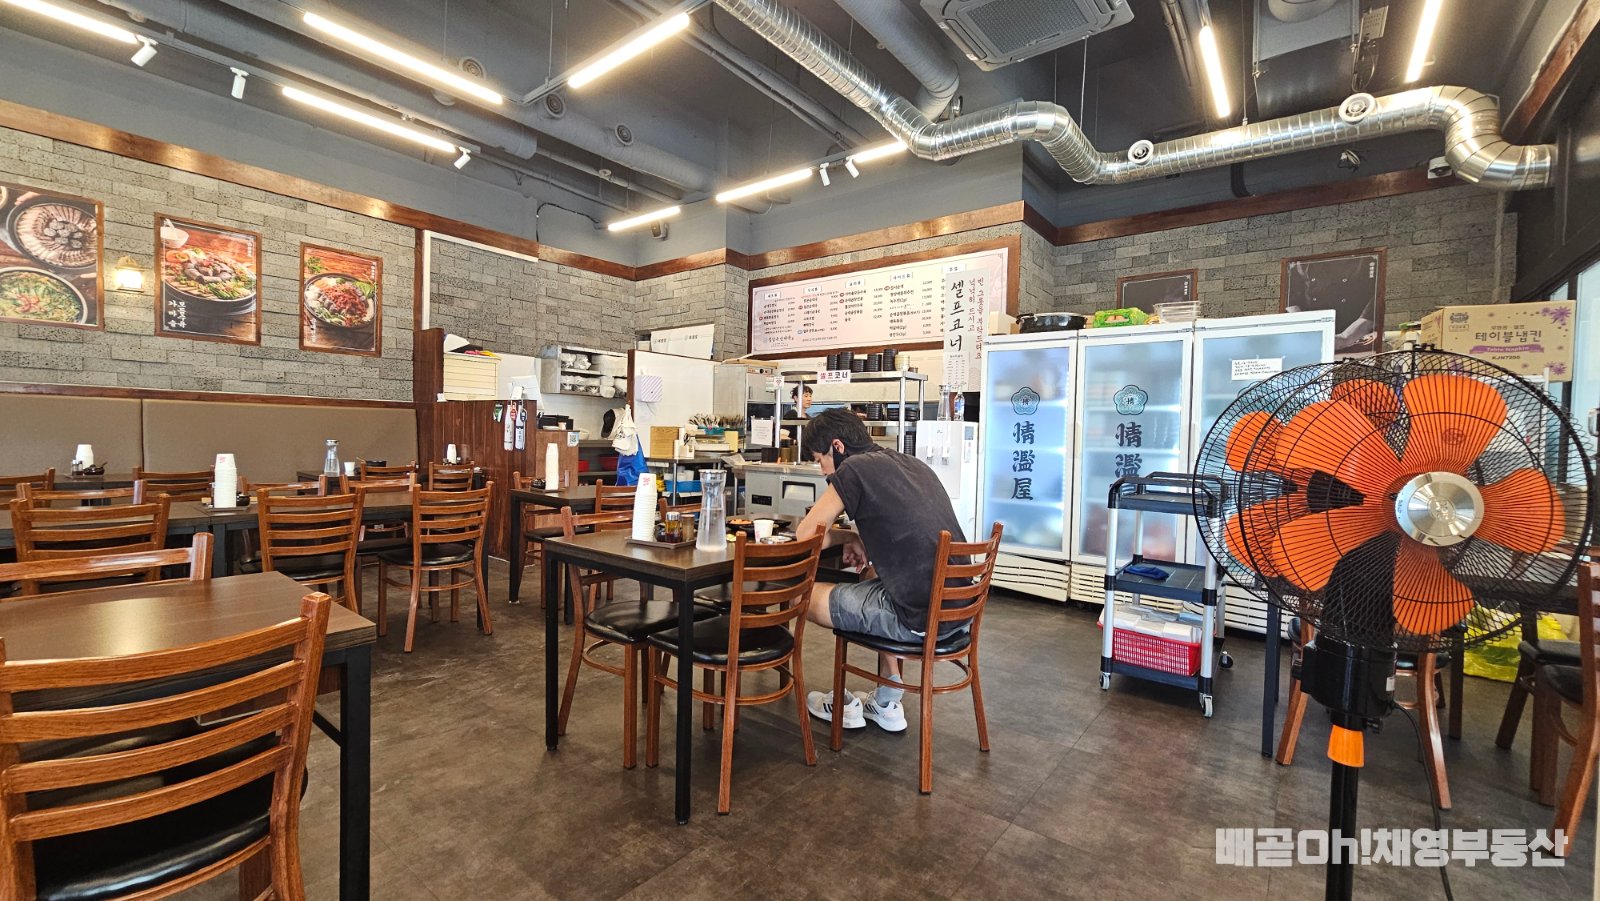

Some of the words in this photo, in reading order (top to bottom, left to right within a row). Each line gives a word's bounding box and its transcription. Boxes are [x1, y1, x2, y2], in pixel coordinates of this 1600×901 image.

[977, 277, 984, 287] 빈
[950, 280, 964, 352] 셀프코너
[1475, 330, 1542, 343] 테이블냅킨
[820, 371, 848, 379] 셀프코너
